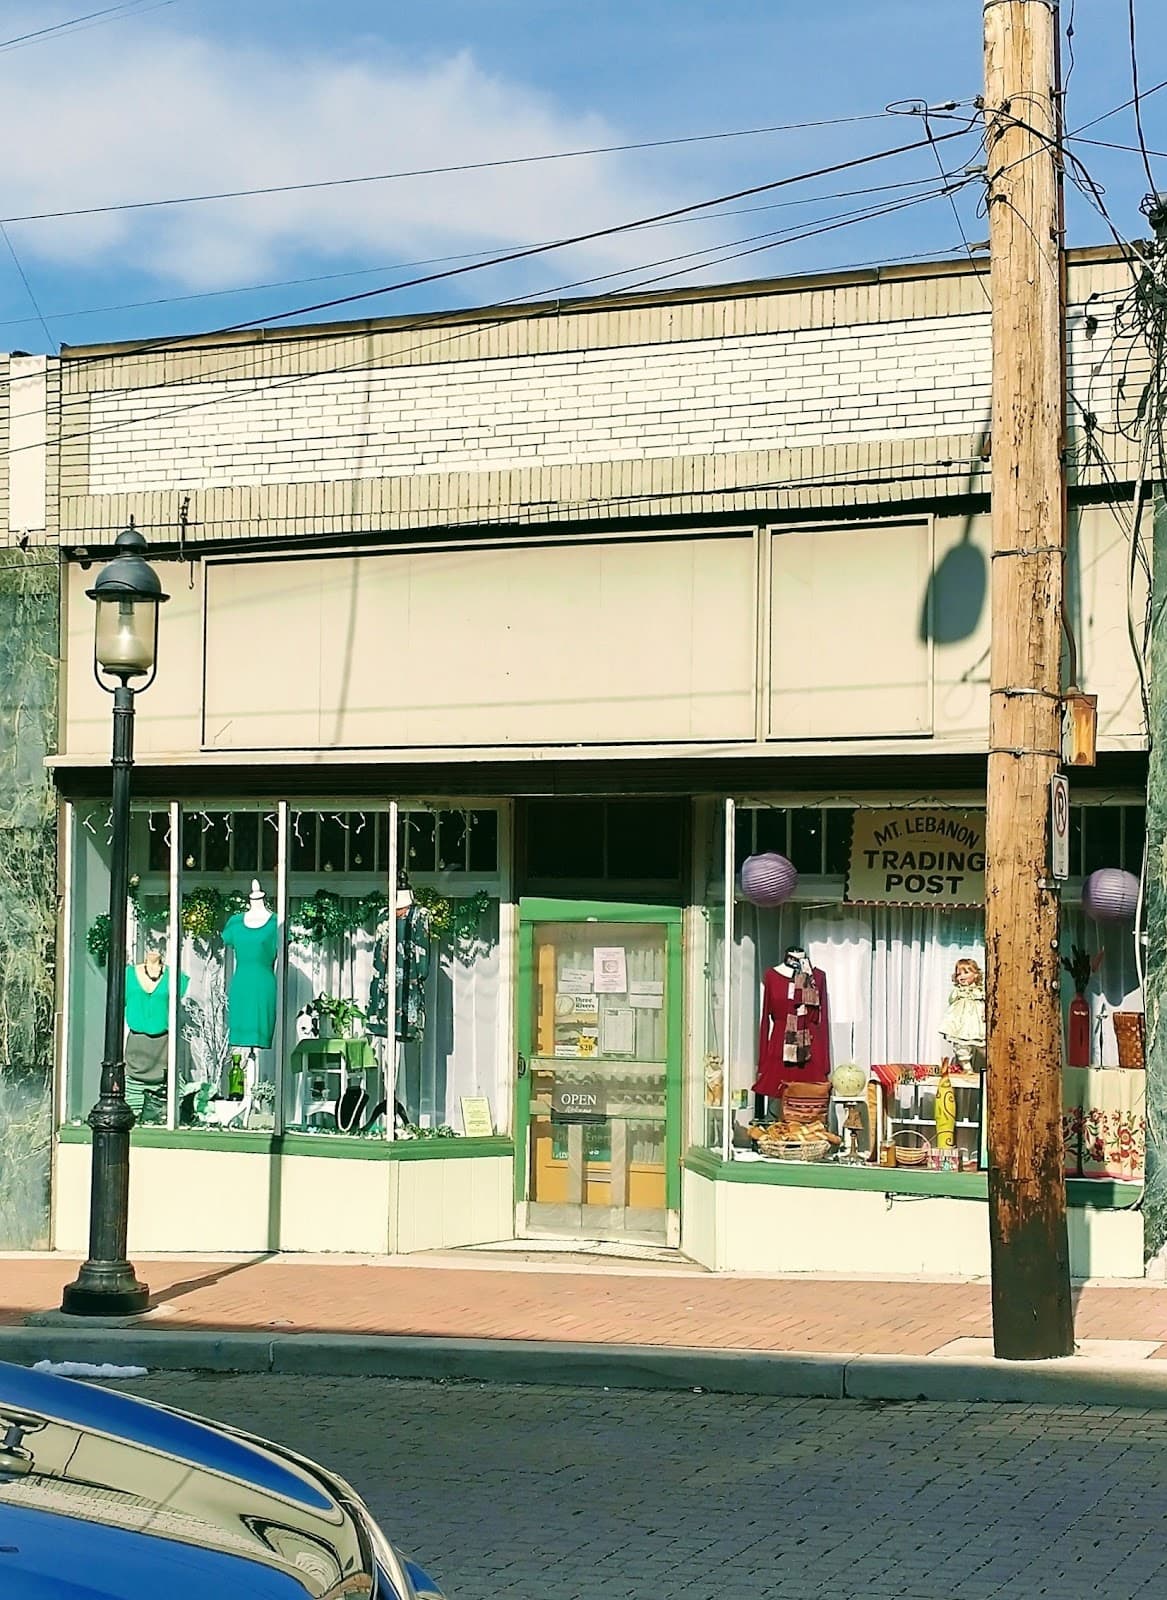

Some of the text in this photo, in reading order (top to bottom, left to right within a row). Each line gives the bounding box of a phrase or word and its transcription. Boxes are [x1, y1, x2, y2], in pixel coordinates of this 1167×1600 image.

[873, 816, 980, 850] MT. LEBANON
[863, 850, 986, 872] TRADING
[885, 873, 964, 895] POST
[561, 1093, 597, 1105] OPEN
